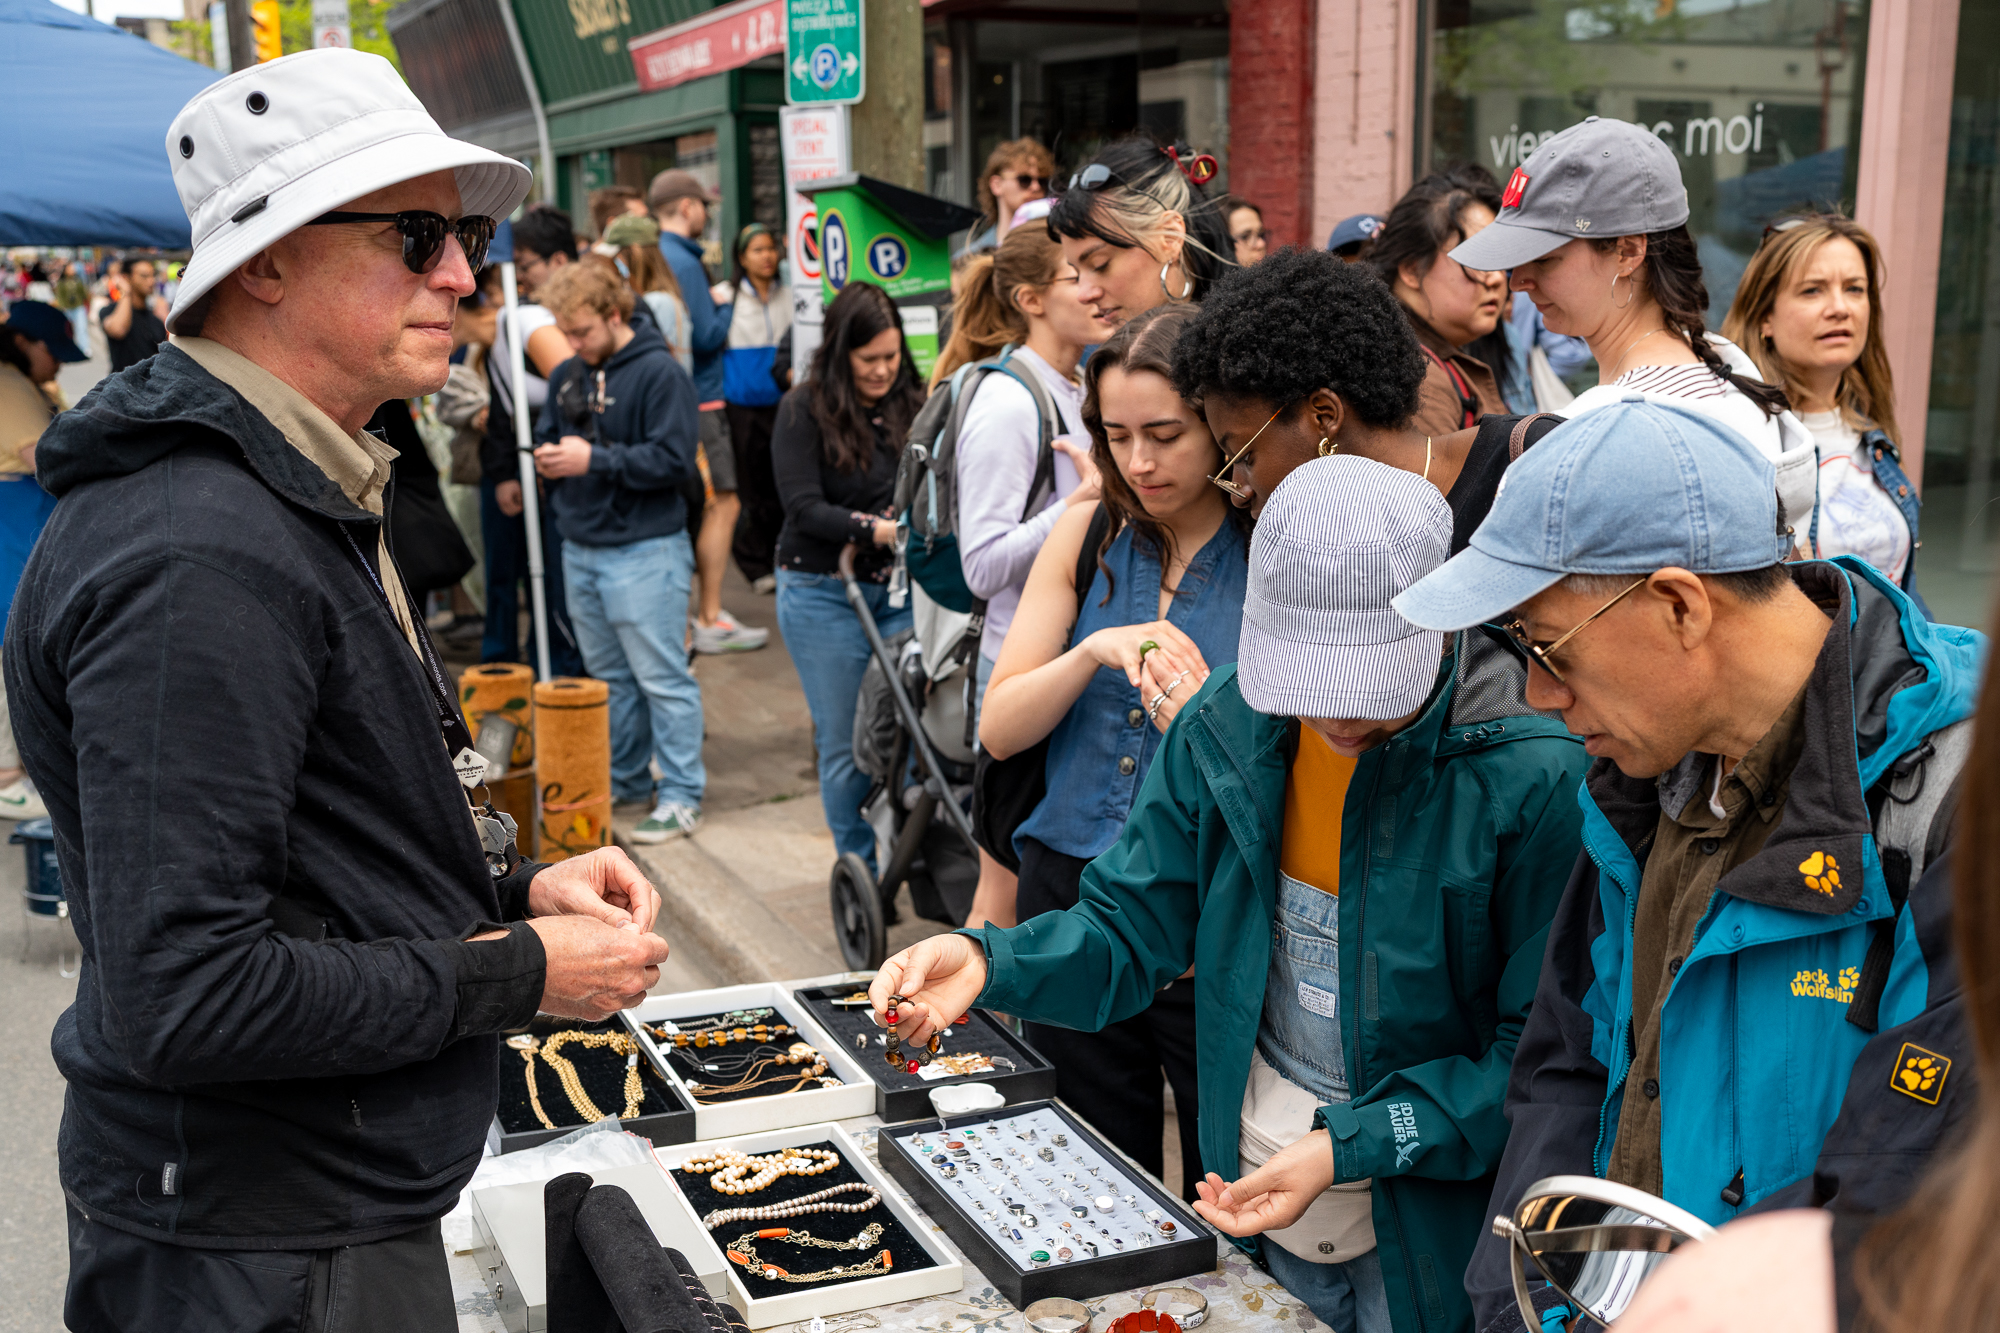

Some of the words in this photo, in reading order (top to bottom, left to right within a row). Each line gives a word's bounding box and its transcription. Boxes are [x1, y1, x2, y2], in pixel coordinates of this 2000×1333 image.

[1684, 102, 1764, 157] moi
[416, 621, 448, 697] vantyghemdiamonds.com
[1792, 968, 1829, 984] Jack
[1386, 1103, 1407, 1143] BAUER
[1399, 1102, 1419, 1138] EDDIE
